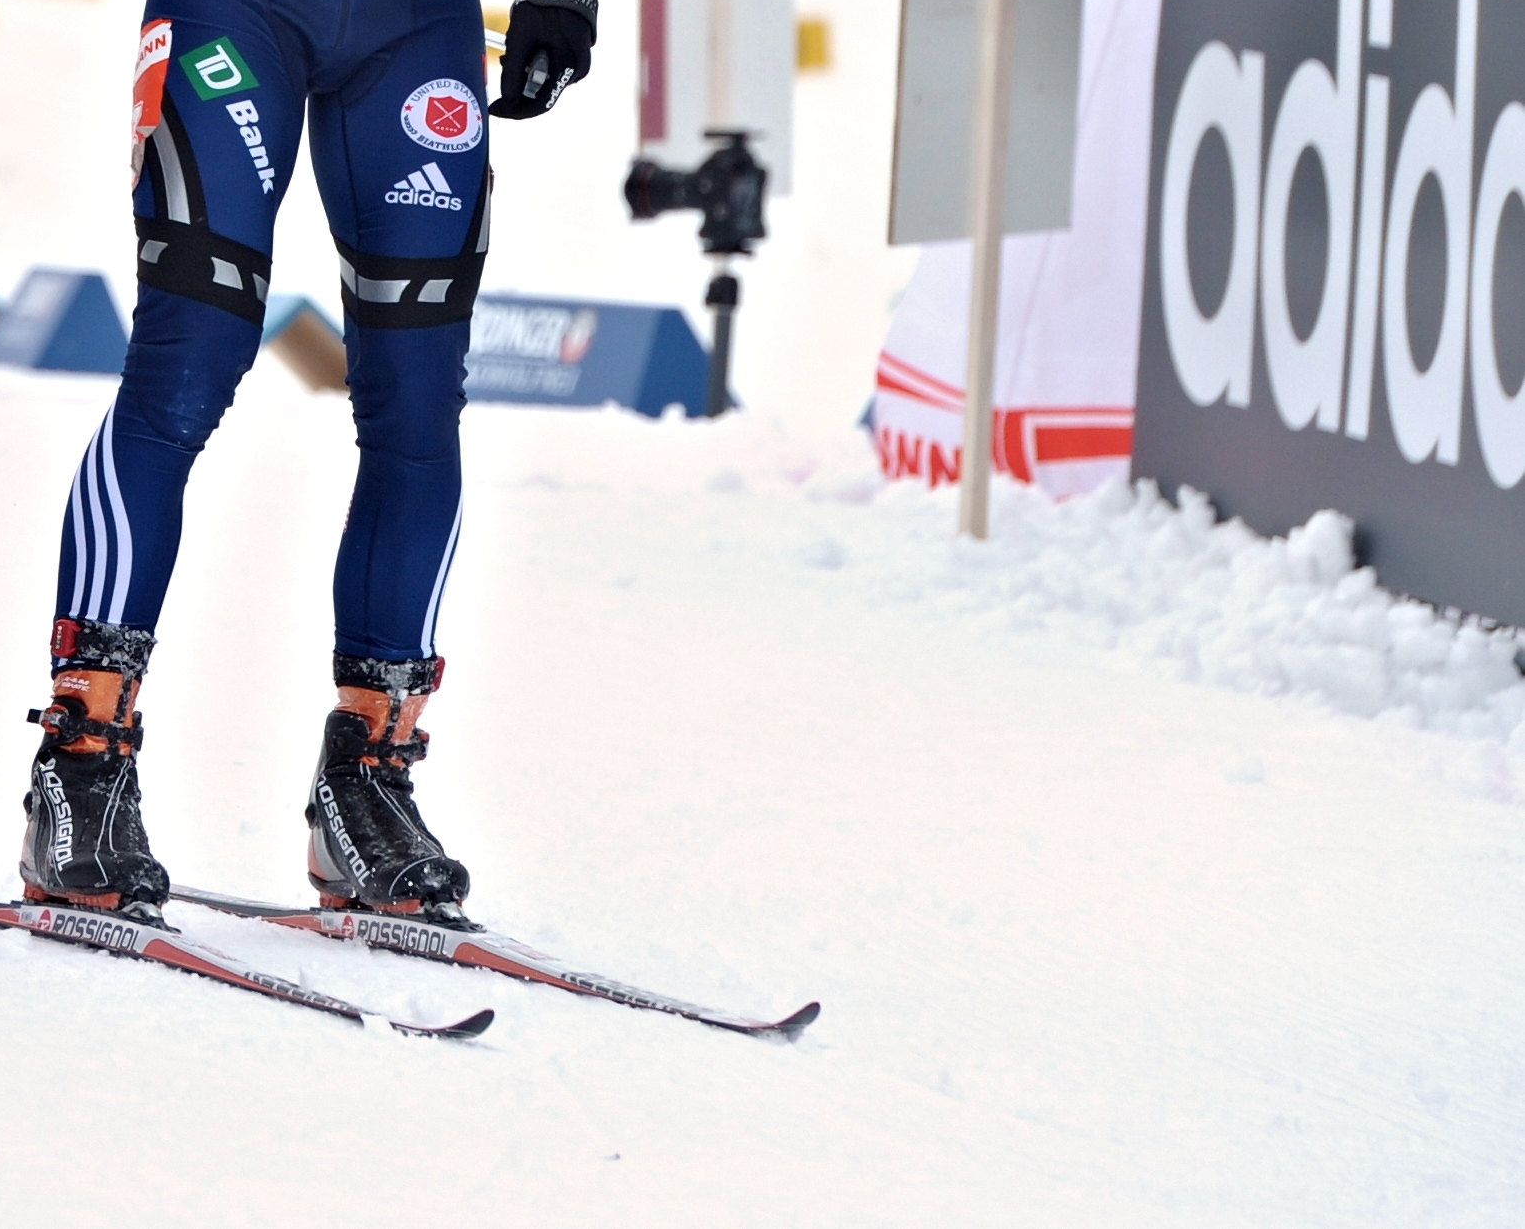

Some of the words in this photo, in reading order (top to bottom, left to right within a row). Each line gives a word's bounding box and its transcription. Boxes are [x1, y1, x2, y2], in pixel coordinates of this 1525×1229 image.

[410, 79, 452, 102] UNITED
[545, 66, 575, 109] adidas
[225, 99, 276, 196] Bank
[416, 134, 471, 151] BIATHLON
[384, 187, 462, 212] adidas
[51, 913, 140, 952] ROSSIGNOL
[356, 918, 450, 956] ROSSIGNOL
